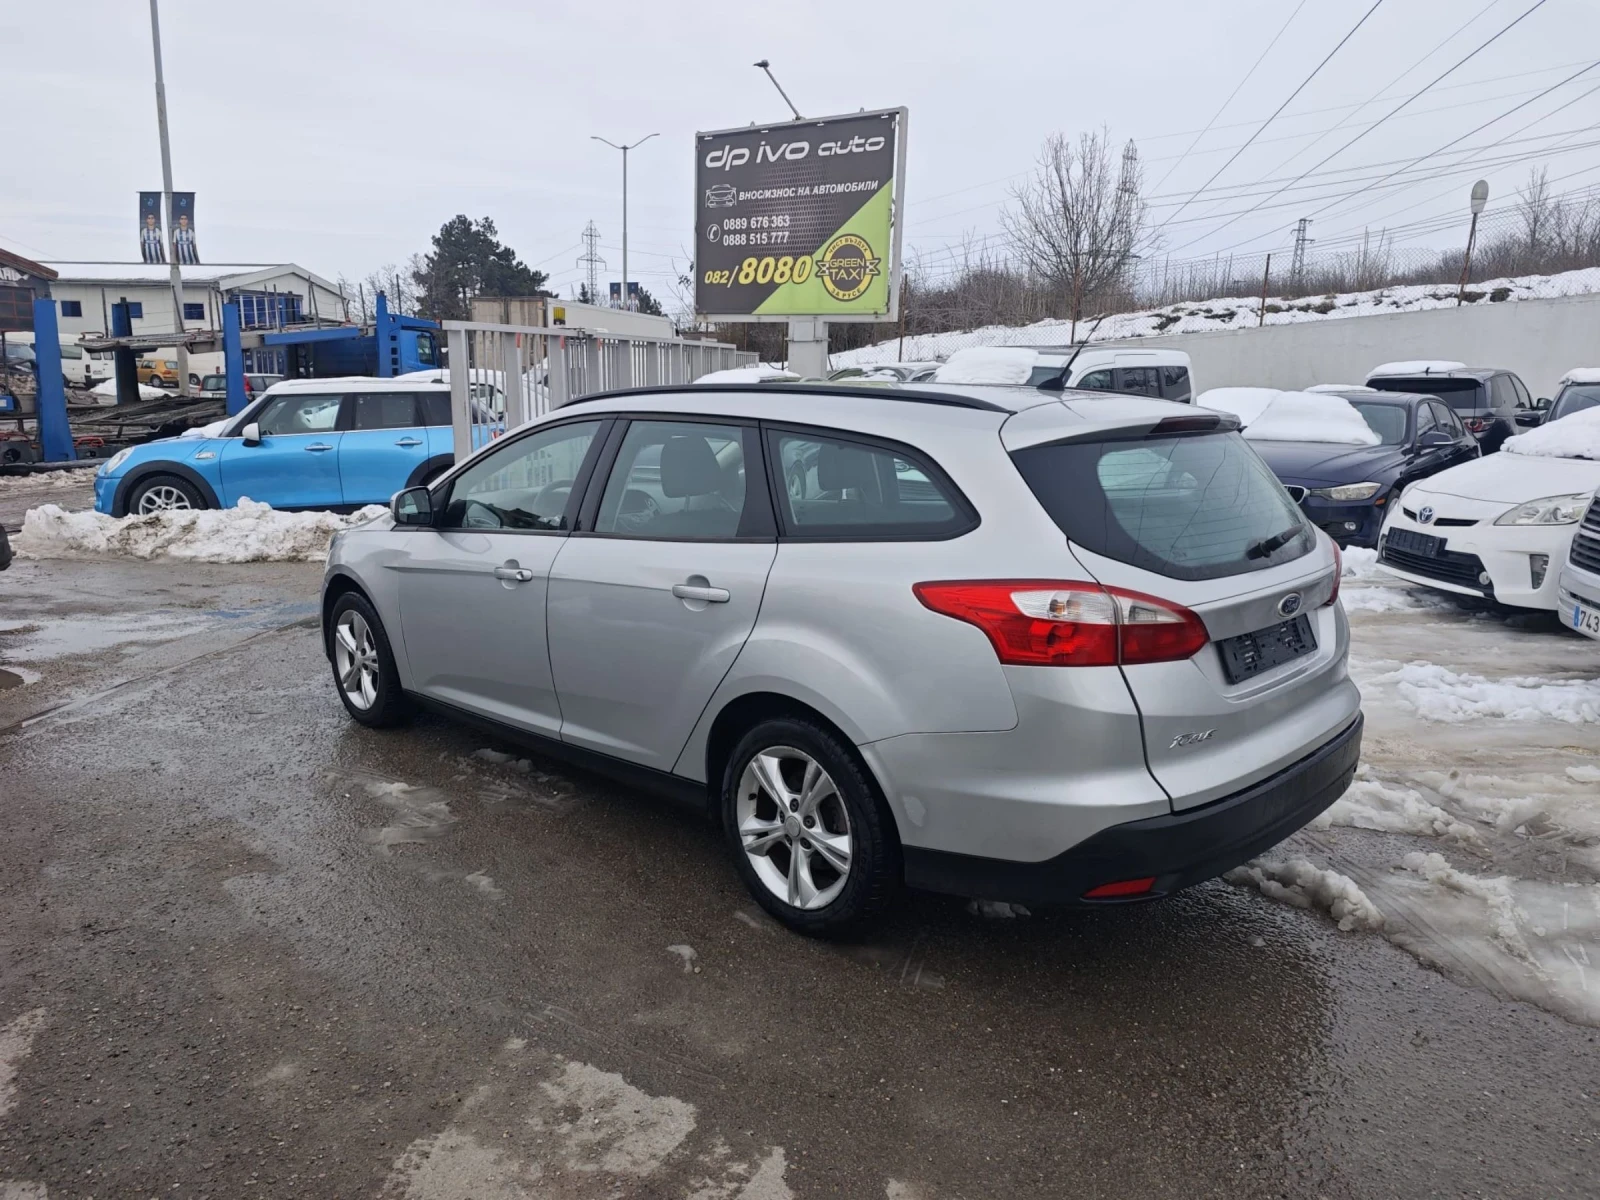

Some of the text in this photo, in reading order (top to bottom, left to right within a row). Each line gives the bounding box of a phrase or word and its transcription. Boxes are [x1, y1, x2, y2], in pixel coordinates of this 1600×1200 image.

[705, 135, 885, 171] dp ivo auto
[739, 180, 878, 200] ВНОС/ИЗНОС НА АВТОМОБИЛИ
[723, 215, 790, 230] 0889 676 363
[723, 231, 789, 246] 0888 515 777
[829, 236, 869, 254] ЧИСТ ВЪЗДУХ
[829, 258, 865, 268] GREEN
[704, 255, 812, 288] 082/8080
[829, 268, 864, 280] TAXI
[831, 287, 862, 298] ЗА РУСЕ
